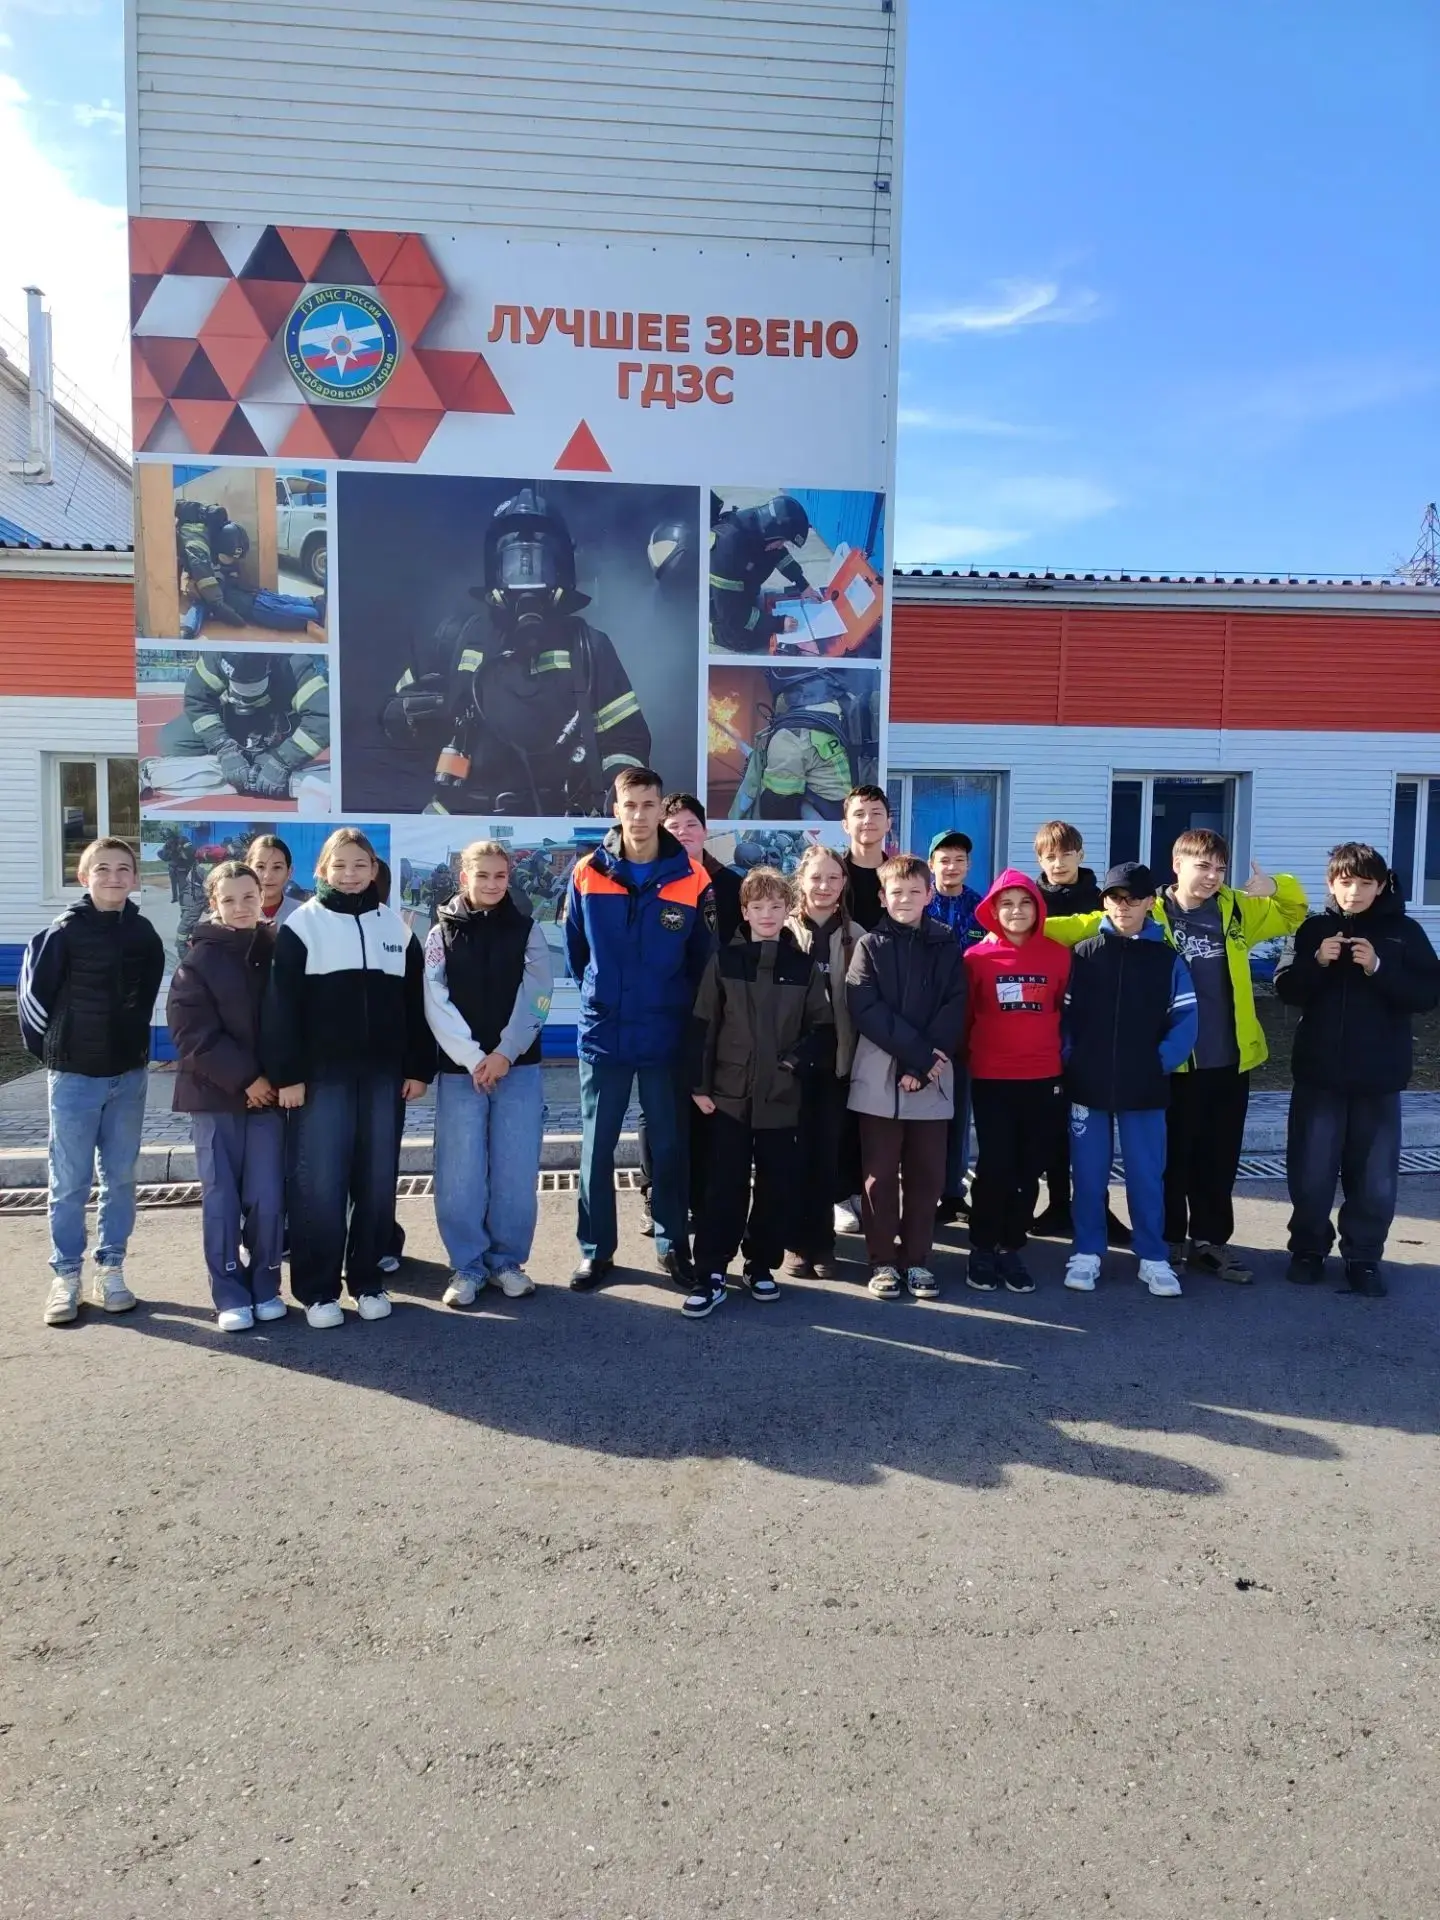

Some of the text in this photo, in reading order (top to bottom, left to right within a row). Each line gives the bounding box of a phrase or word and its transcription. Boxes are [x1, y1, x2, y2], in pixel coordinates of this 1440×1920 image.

[300, 289, 382, 319] ГУ МЧС России
[487, 304, 859, 359] ЛУЧШЕЕ ЗВЕНО
[290, 354, 301, 369] по
[376, 353, 395, 382] краю
[618, 361, 734, 409] ГДЗС
